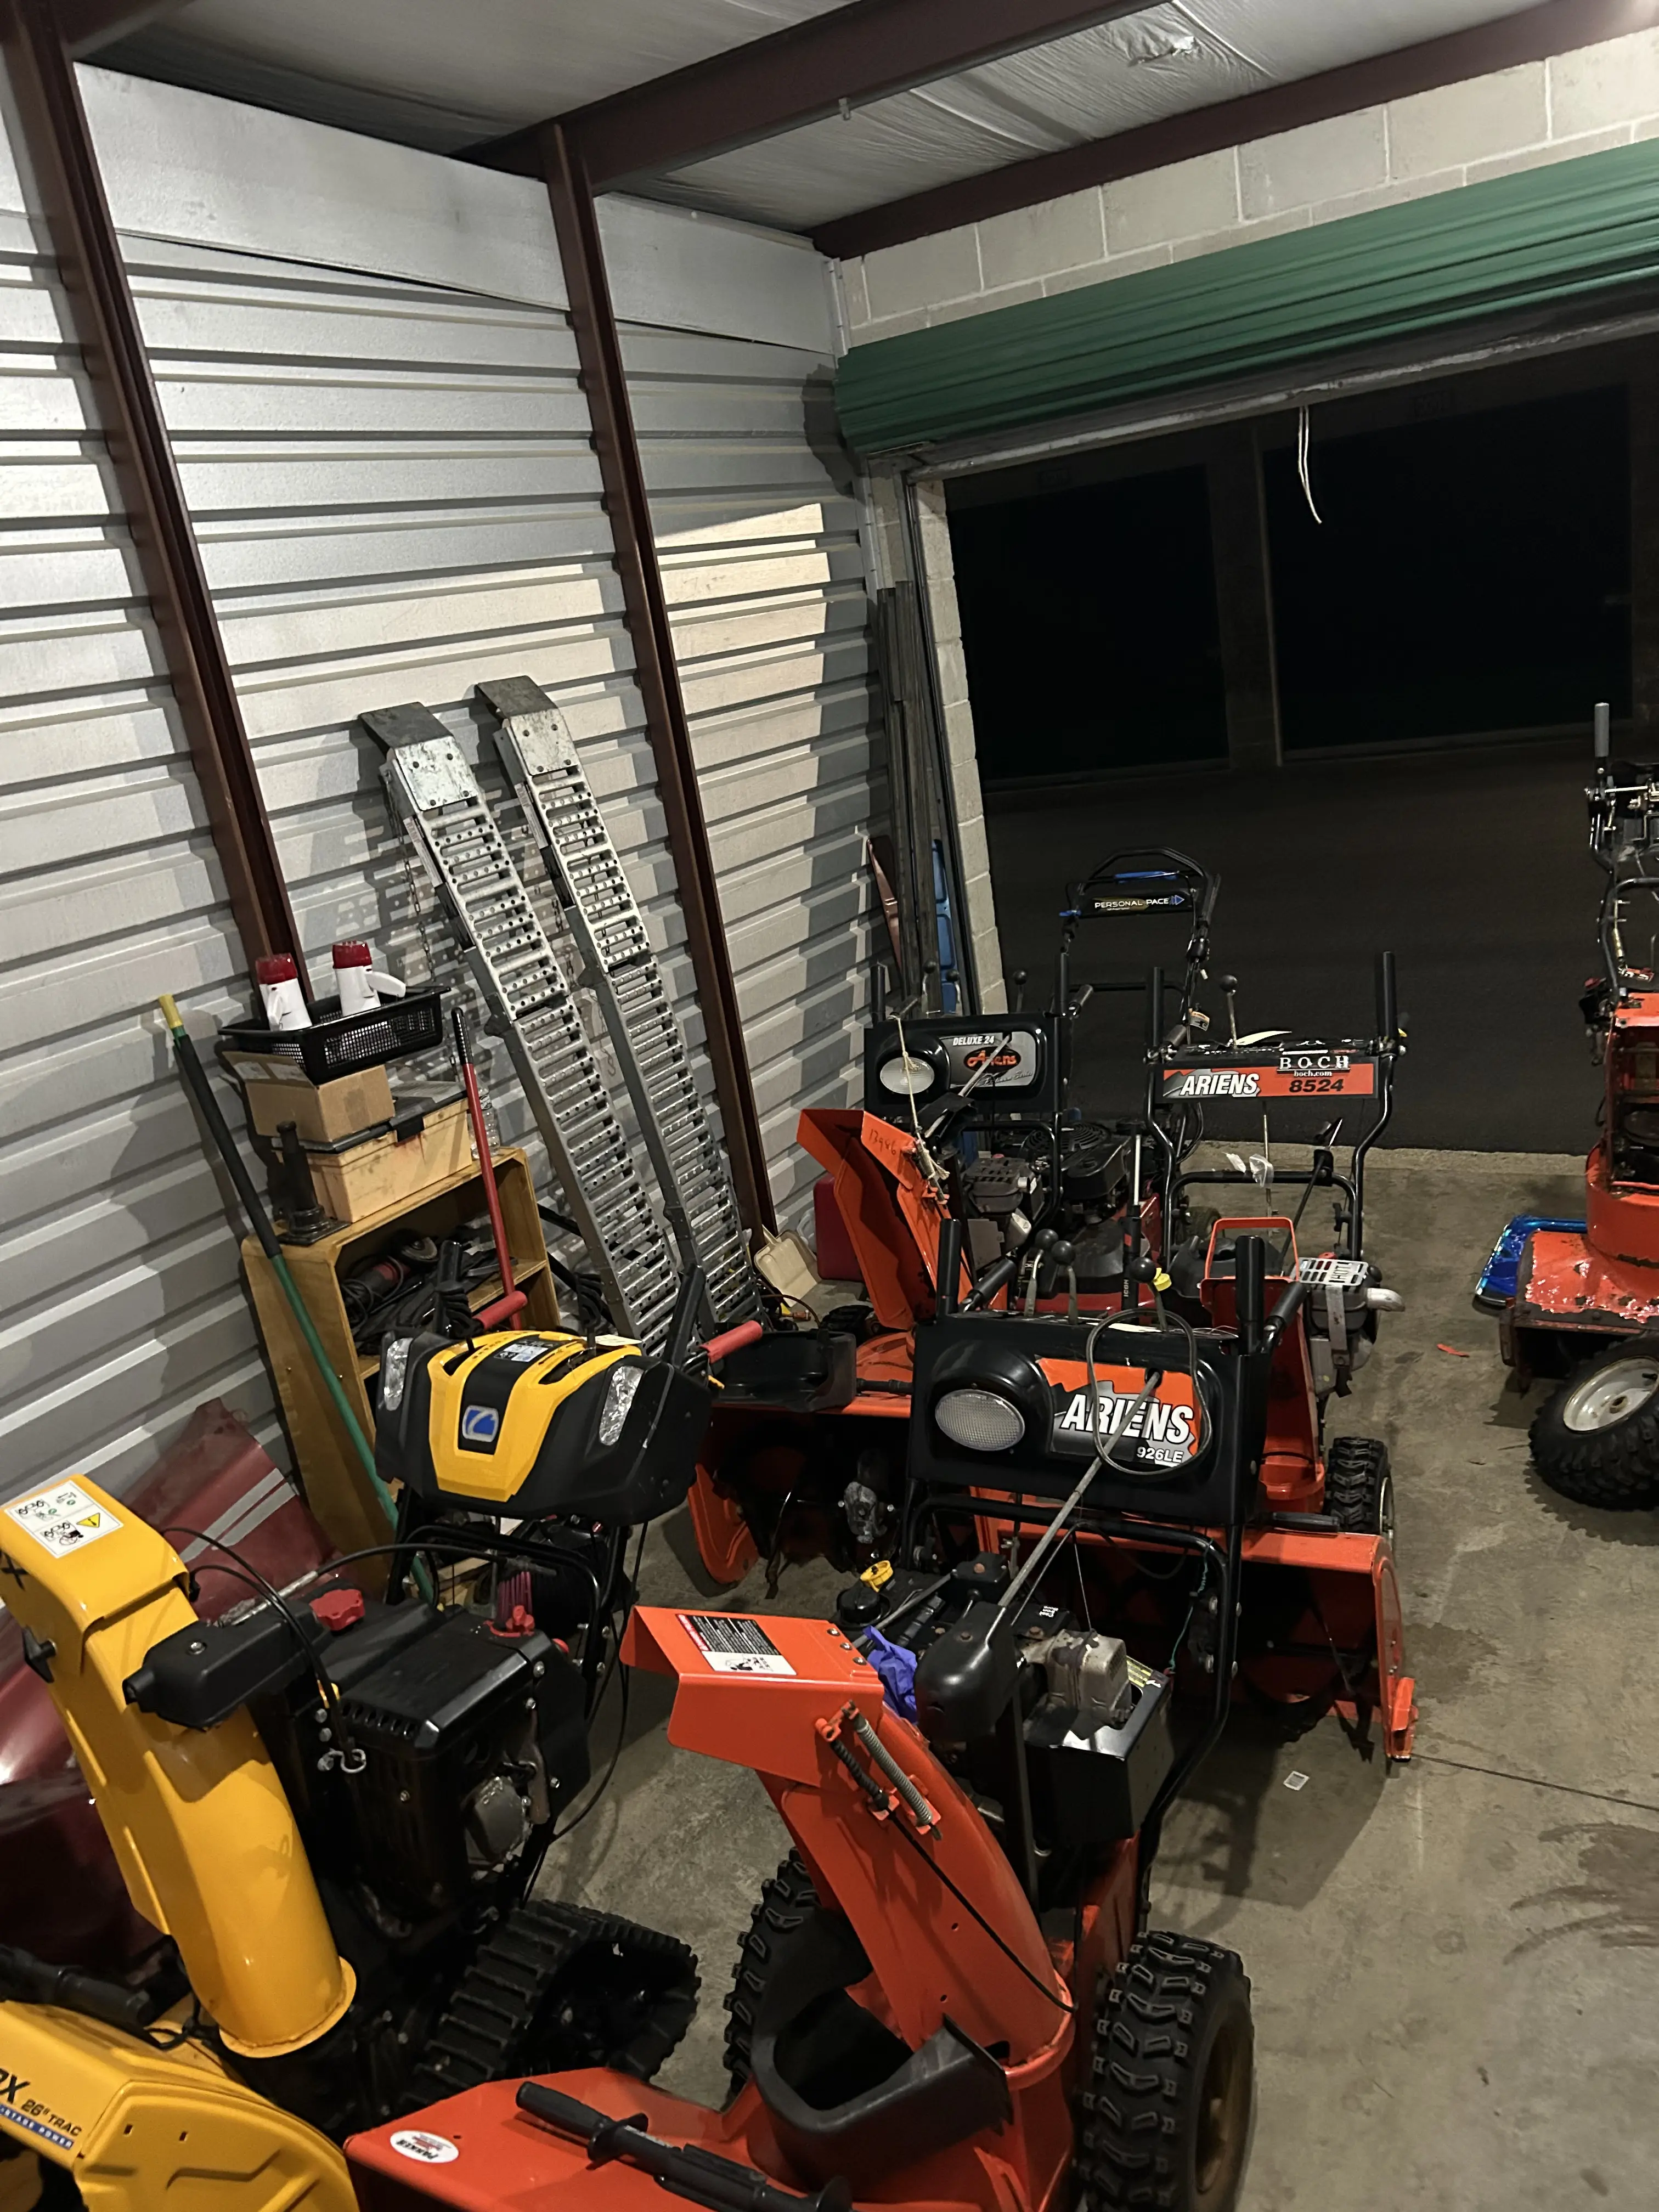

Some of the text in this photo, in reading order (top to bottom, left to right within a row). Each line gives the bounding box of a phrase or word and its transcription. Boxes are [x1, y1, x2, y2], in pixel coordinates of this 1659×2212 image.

[1094, 900, 1143, 909] PERSONAL
[952, 1036, 995, 1046] DELUXE 24
[1279, 1055, 1349, 1069] BOCH
[1180, 1073, 1260, 1096] ARIENS
[1289, 1079, 1344, 1093] 8524
[1060, 1393, 1194, 1444] ARIENS
[1137, 1446, 1183, 1463] 926LE
[21, 2098, 50, 2116] 26"
[48, 2114, 82, 2136] TRAC
[38, 2126, 72, 2148] POWER
